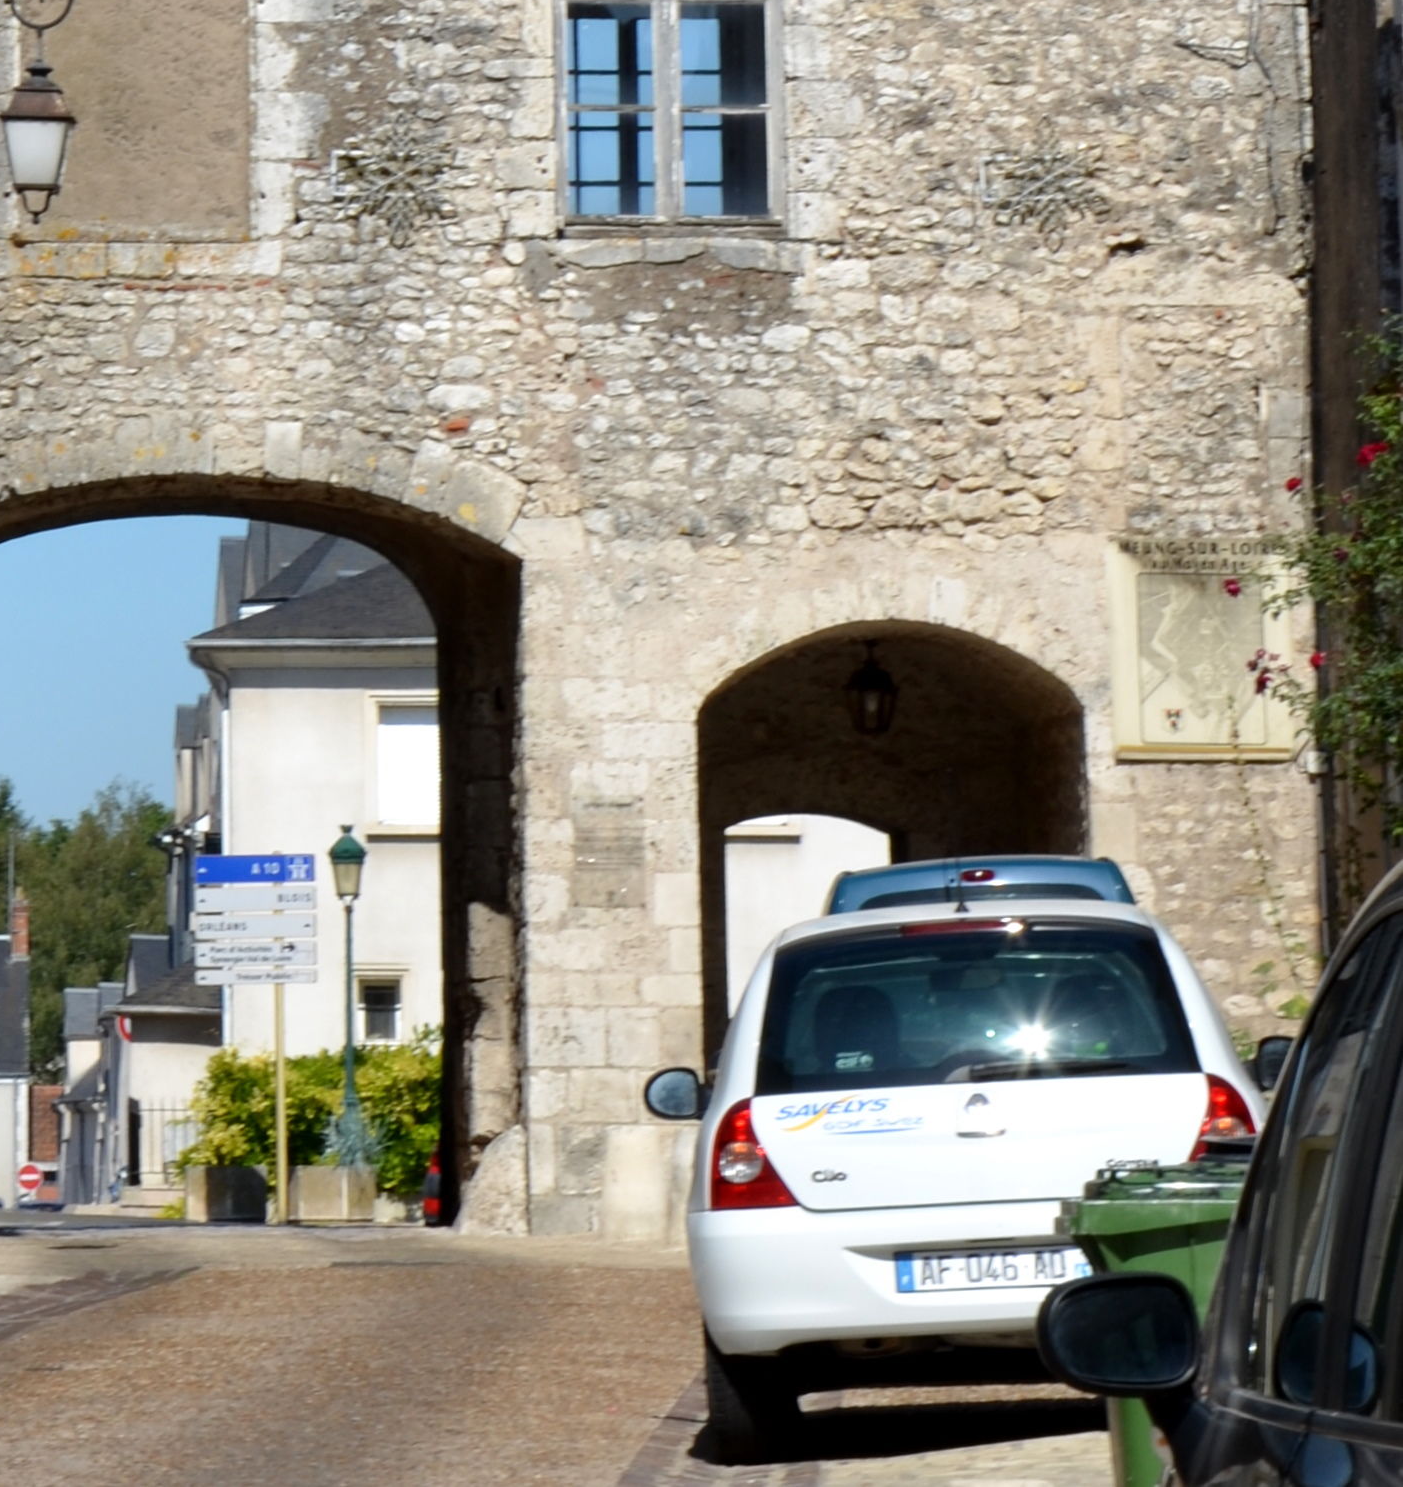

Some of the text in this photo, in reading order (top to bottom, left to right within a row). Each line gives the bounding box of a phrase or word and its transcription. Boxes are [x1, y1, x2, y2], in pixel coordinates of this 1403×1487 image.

[251, 861, 281, 875] A 10
[277, 892, 312, 903] BLOIS
[774, 1097, 890, 1121] SAVELYS
[811, 1169, 847, 1184] Clio
